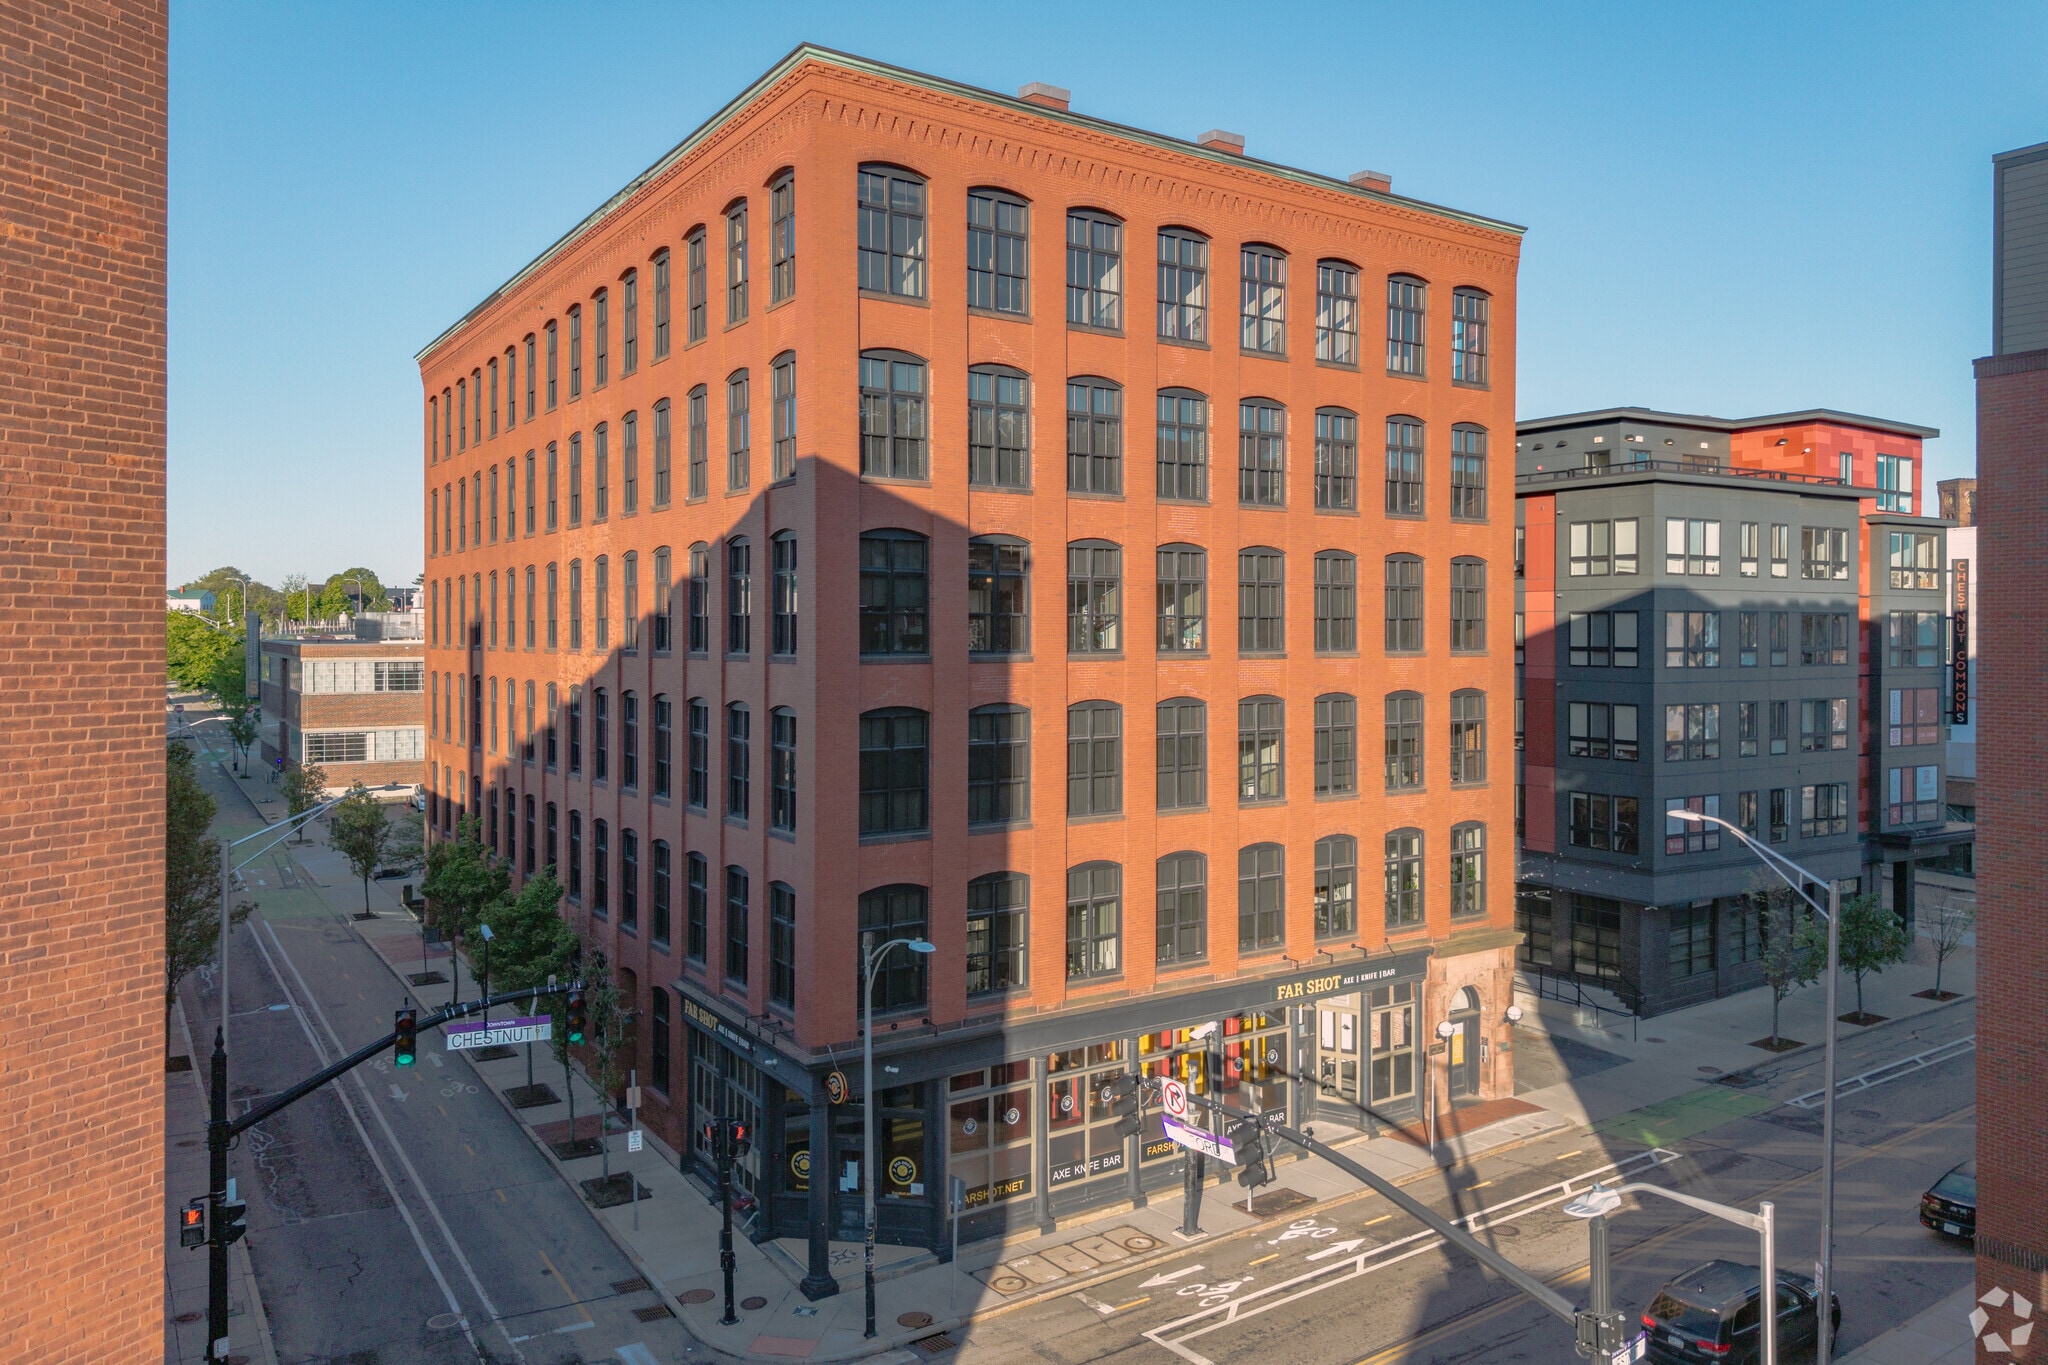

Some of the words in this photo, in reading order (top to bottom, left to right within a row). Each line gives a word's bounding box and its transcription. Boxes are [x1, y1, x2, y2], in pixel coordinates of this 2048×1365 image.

[1956, 561, 1966, 643] CHESTNUT
[1955, 651, 1966, 722] COMMONS
[1277, 982, 1304, 1000] FAR
[1306, 975, 1342, 994] SHOT
[1343, 976, 1354, 985] AXE
[1361, 972, 1378, 981] KNIFE
[1383, 968, 1396, 978] BAR
[684, 999, 698, 1020] FAR
[699, 1008, 718, 1032] SHOT
[452, 1027, 532, 1048] CHESTNUT
[1052, 1167, 1071, 1181] AXE
[1074, 1160, 1100, 1175] KNFE
[1103, 1154, 1121, 1168] BAR
[964, 1179, 1025, 1204] ARSHOT.NET
